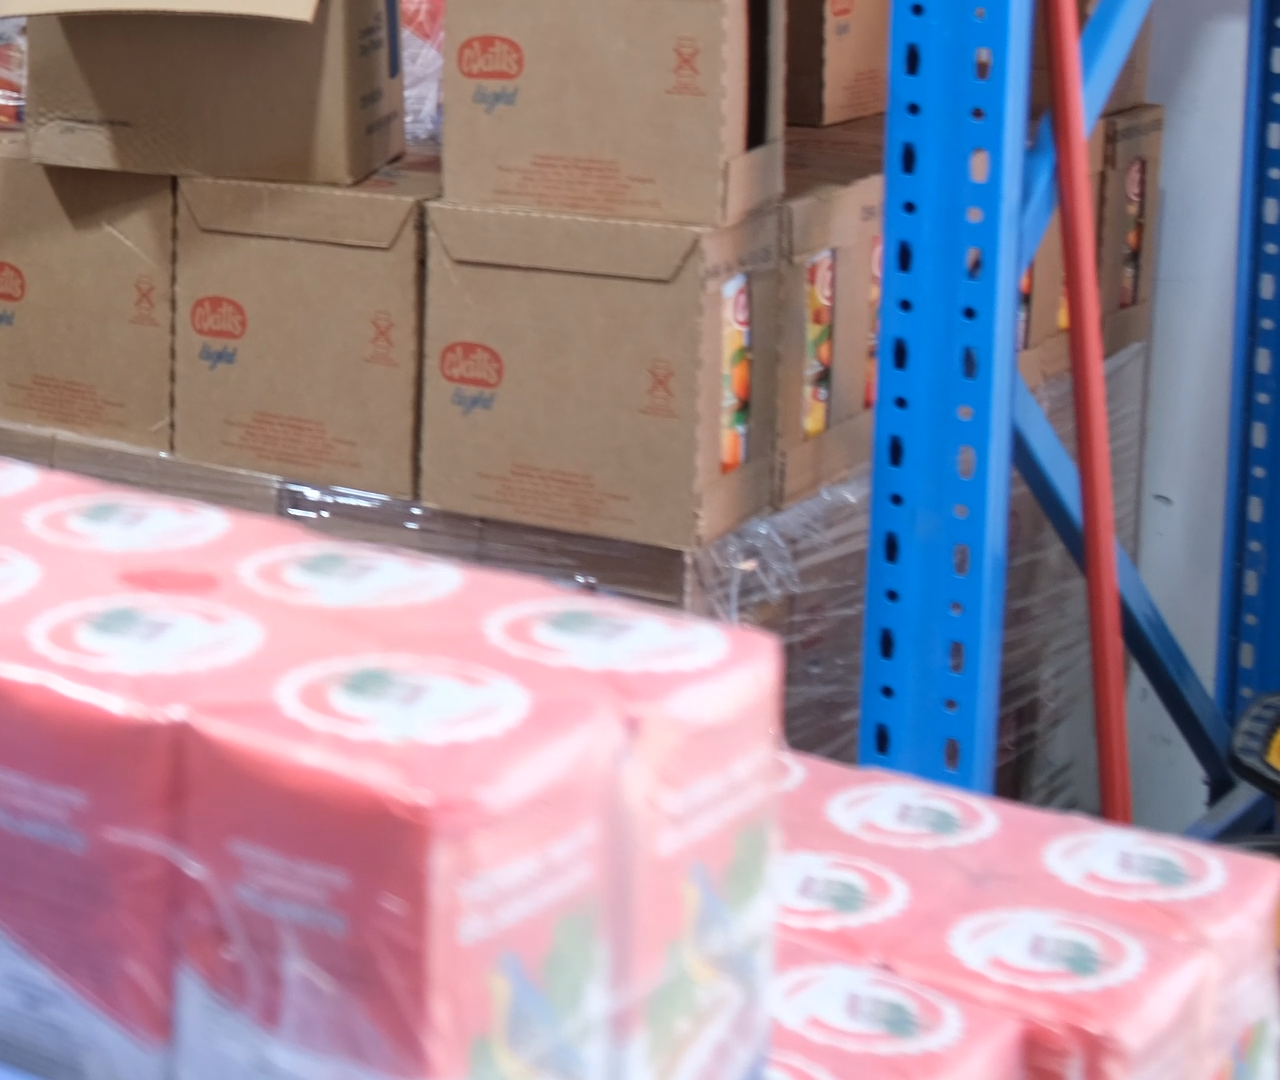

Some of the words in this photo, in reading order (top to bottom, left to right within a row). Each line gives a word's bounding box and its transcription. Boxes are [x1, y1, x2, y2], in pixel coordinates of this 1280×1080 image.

[471, 83, 519, 115] light
[197, 341, 239, 371] light
[450, 387, 498, 416] light
